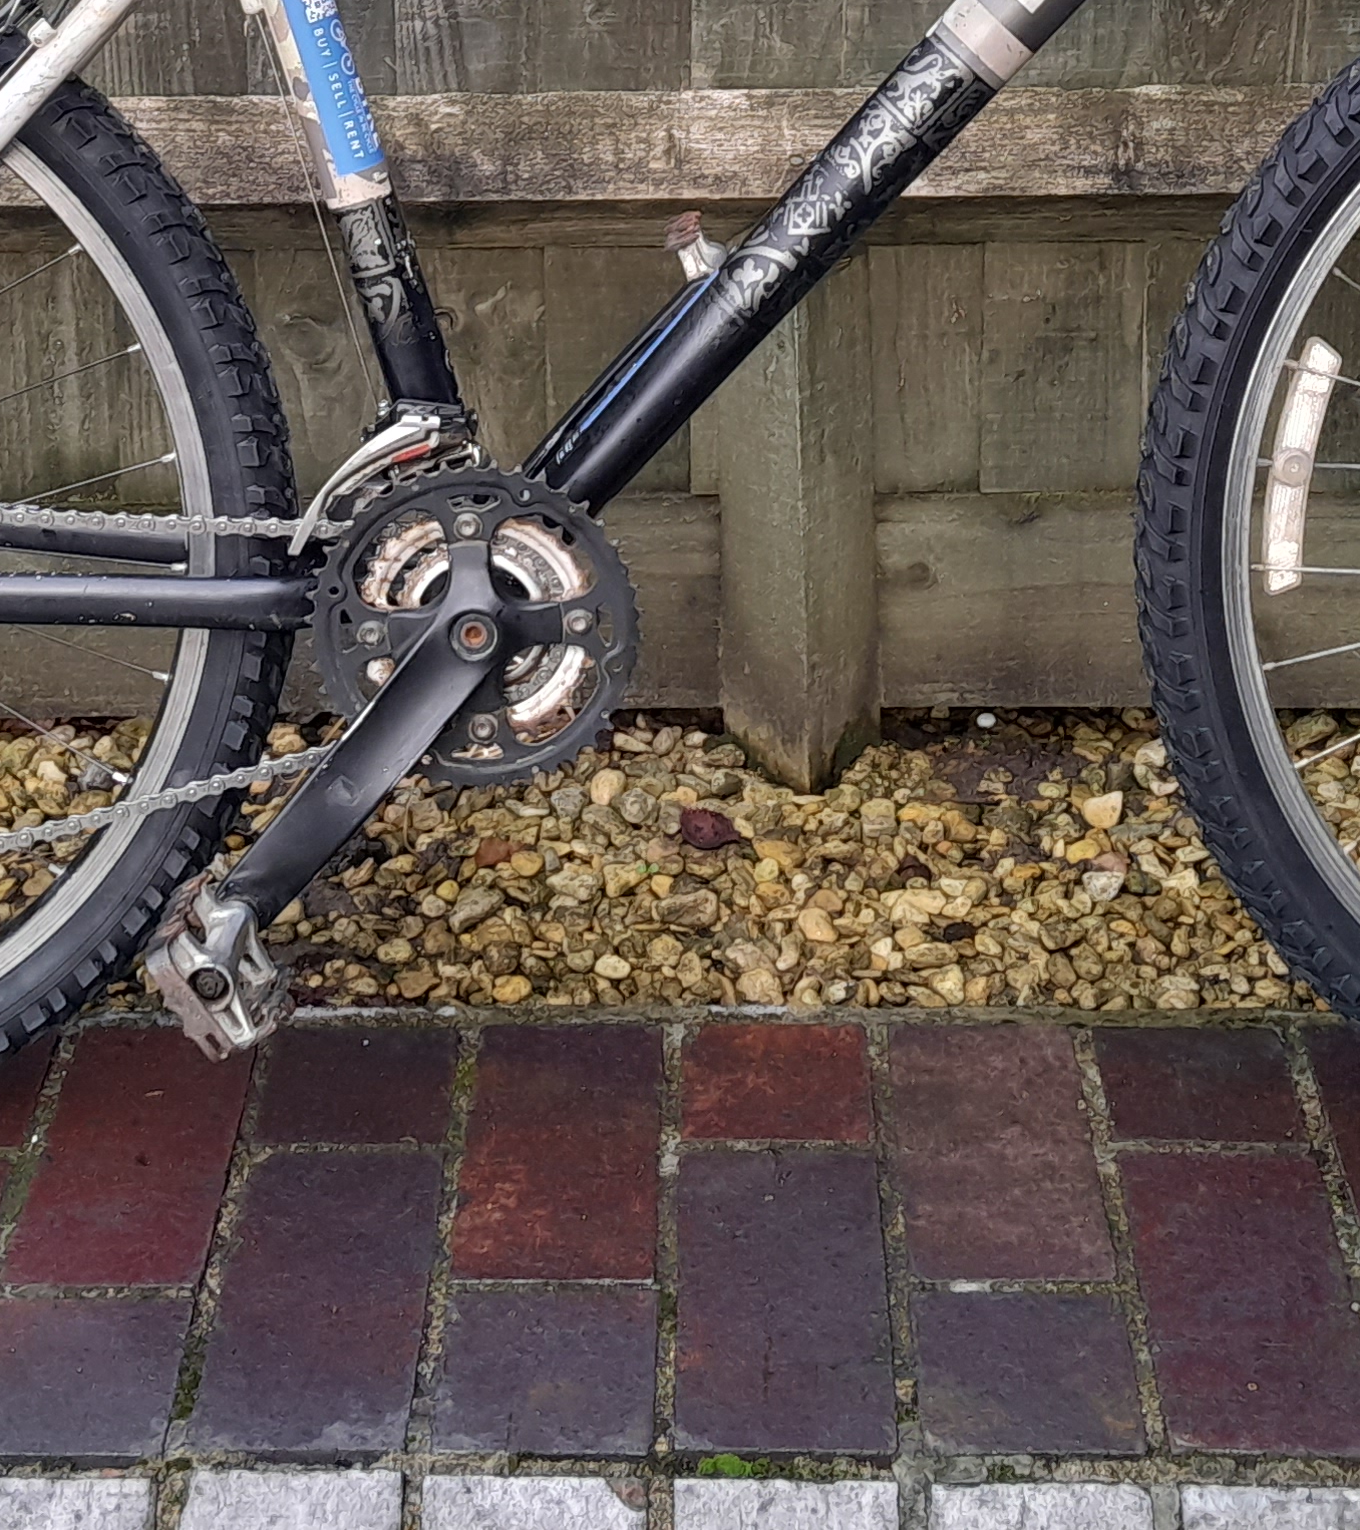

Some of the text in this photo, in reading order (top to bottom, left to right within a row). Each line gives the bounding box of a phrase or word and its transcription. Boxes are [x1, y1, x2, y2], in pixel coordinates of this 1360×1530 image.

[313, 27, 365, 159] BUY SELL RENT
